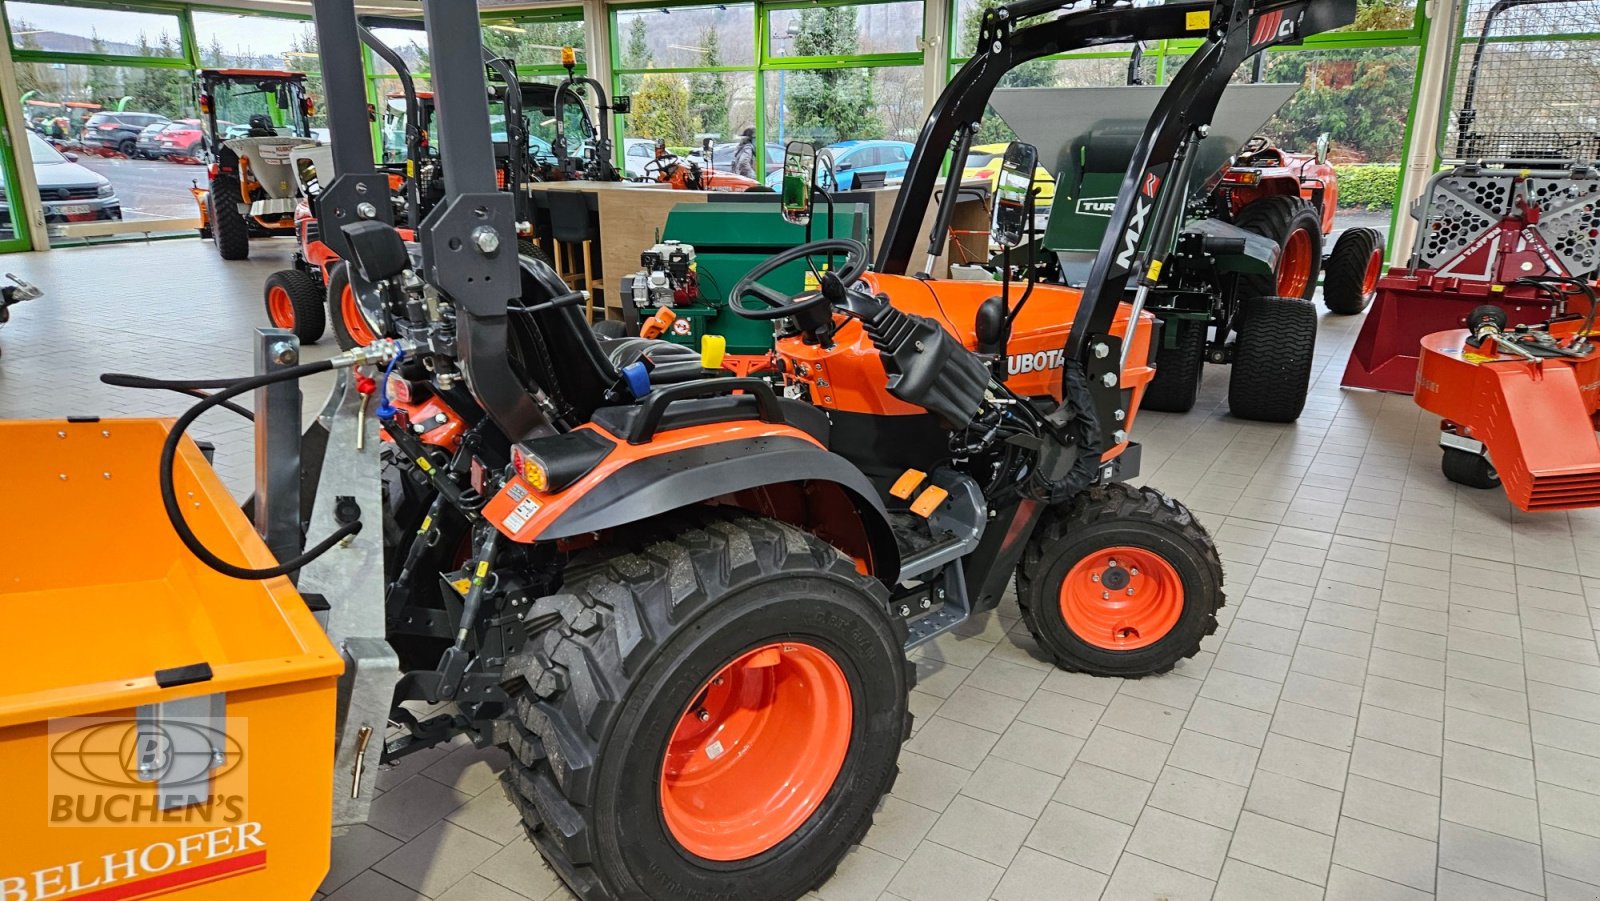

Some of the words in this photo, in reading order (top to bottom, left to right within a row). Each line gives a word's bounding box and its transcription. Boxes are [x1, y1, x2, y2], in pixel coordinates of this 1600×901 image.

[1082, 202, 1116, 211] TUR
[1115, 196, 1152, 270] MX
[1463, 227, 1502, 256] TAJFUN
[1007, 348, 1066, 376] UBOTA
[0, 821, 266, 901] BELHOFER
